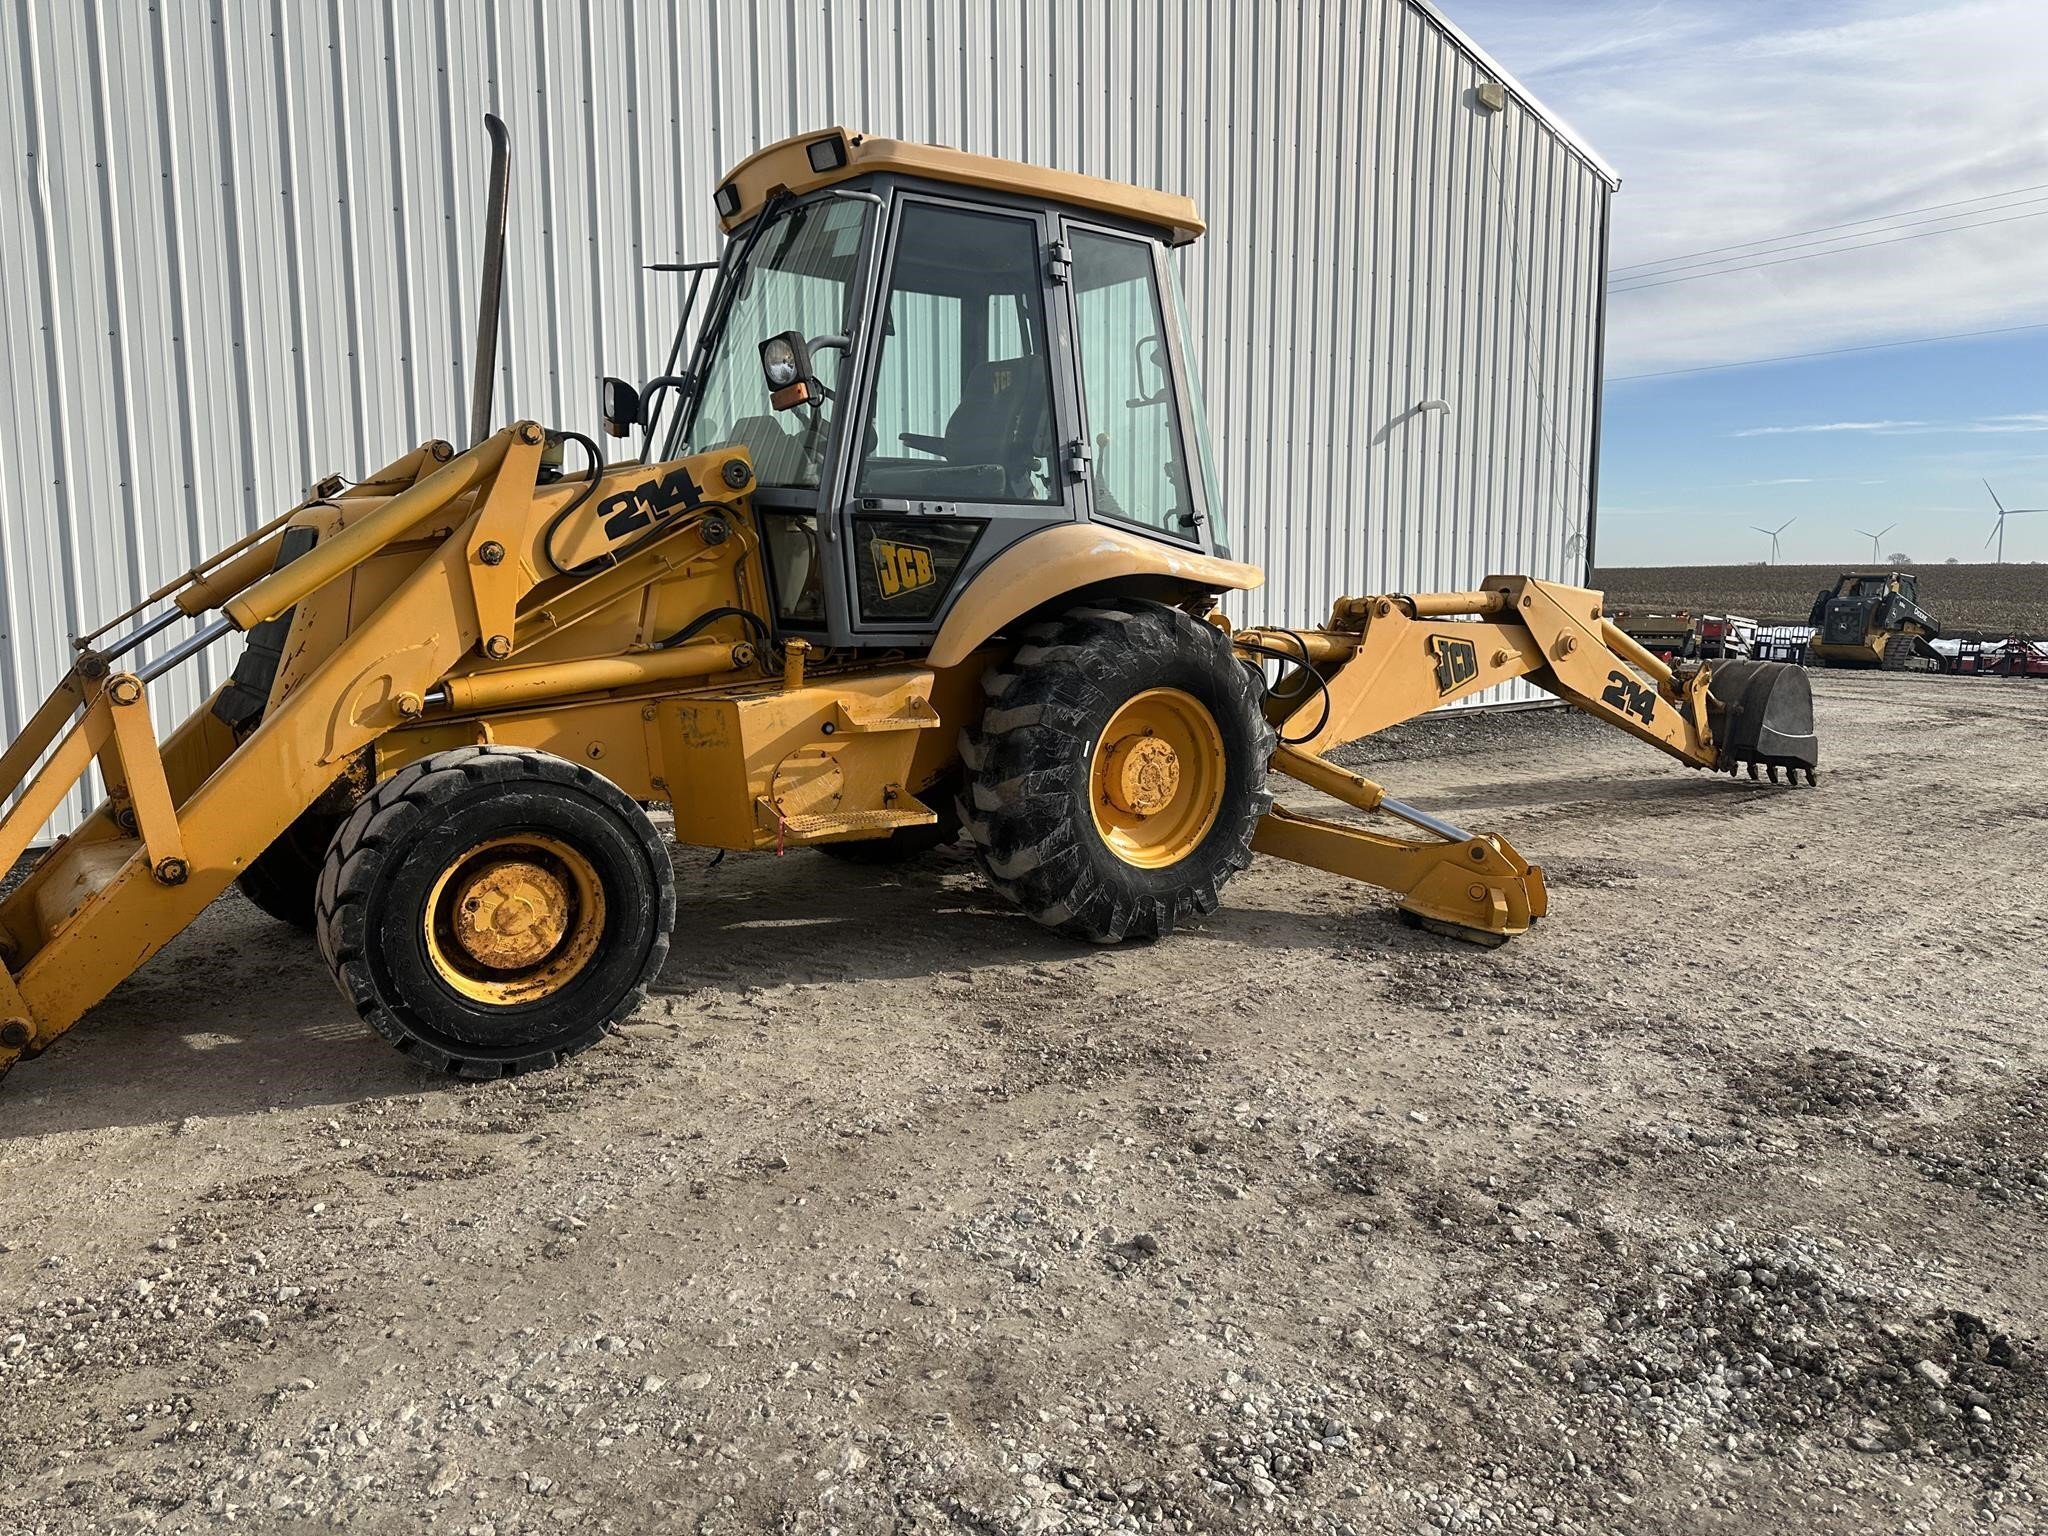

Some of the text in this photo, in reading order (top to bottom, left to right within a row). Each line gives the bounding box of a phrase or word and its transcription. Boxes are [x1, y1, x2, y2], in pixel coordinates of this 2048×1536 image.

[597, 466, 704, 541] 214
[880, 543, 932, 596] JCB
[1437, 640, 1474, 691] JCB
[1601, 670, 1657, 726] 214
